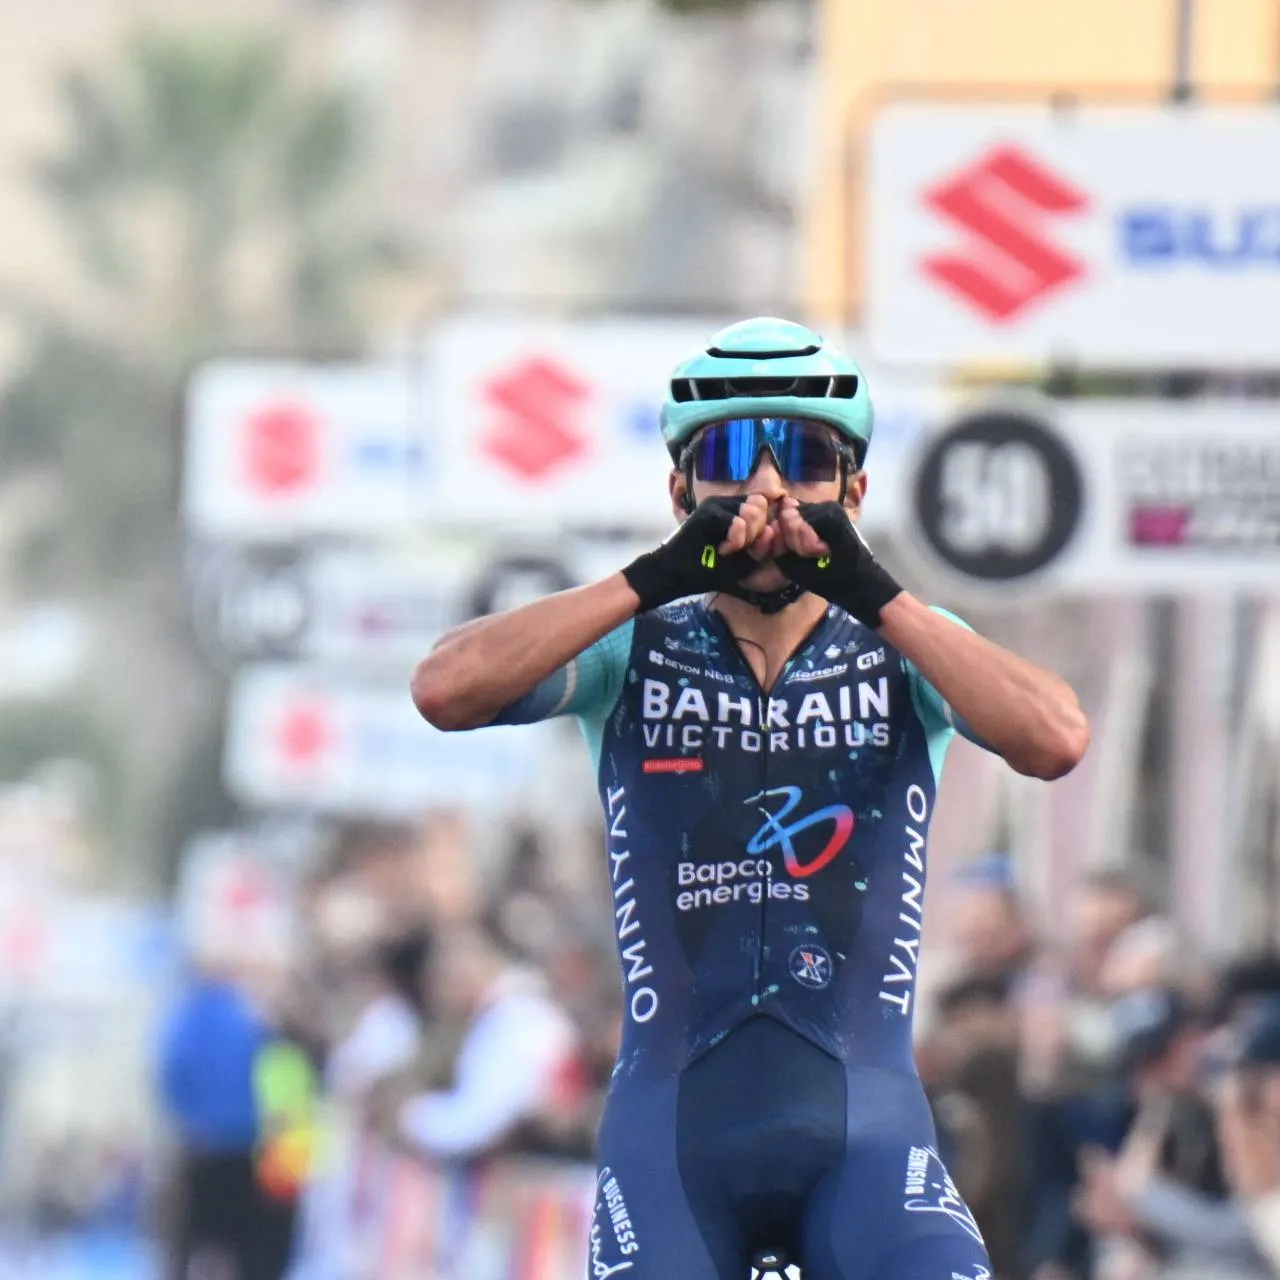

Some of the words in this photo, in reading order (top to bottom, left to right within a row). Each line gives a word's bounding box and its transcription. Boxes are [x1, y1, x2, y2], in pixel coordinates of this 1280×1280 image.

[935, 440, 1051, 555] 50
[643, 676, 889, 728] BAHRAIN
[643, 722, 890, 752] VICTORIOUS
[606, 785, 658, 1023] OMNIYAT
[676, 877, 810, 910] energies
[678, 859, 773, 886] Bapco
[878, 783, 928, 1016] OMNIYAT
[602, 1176, 639, 1256] BUSINESS
